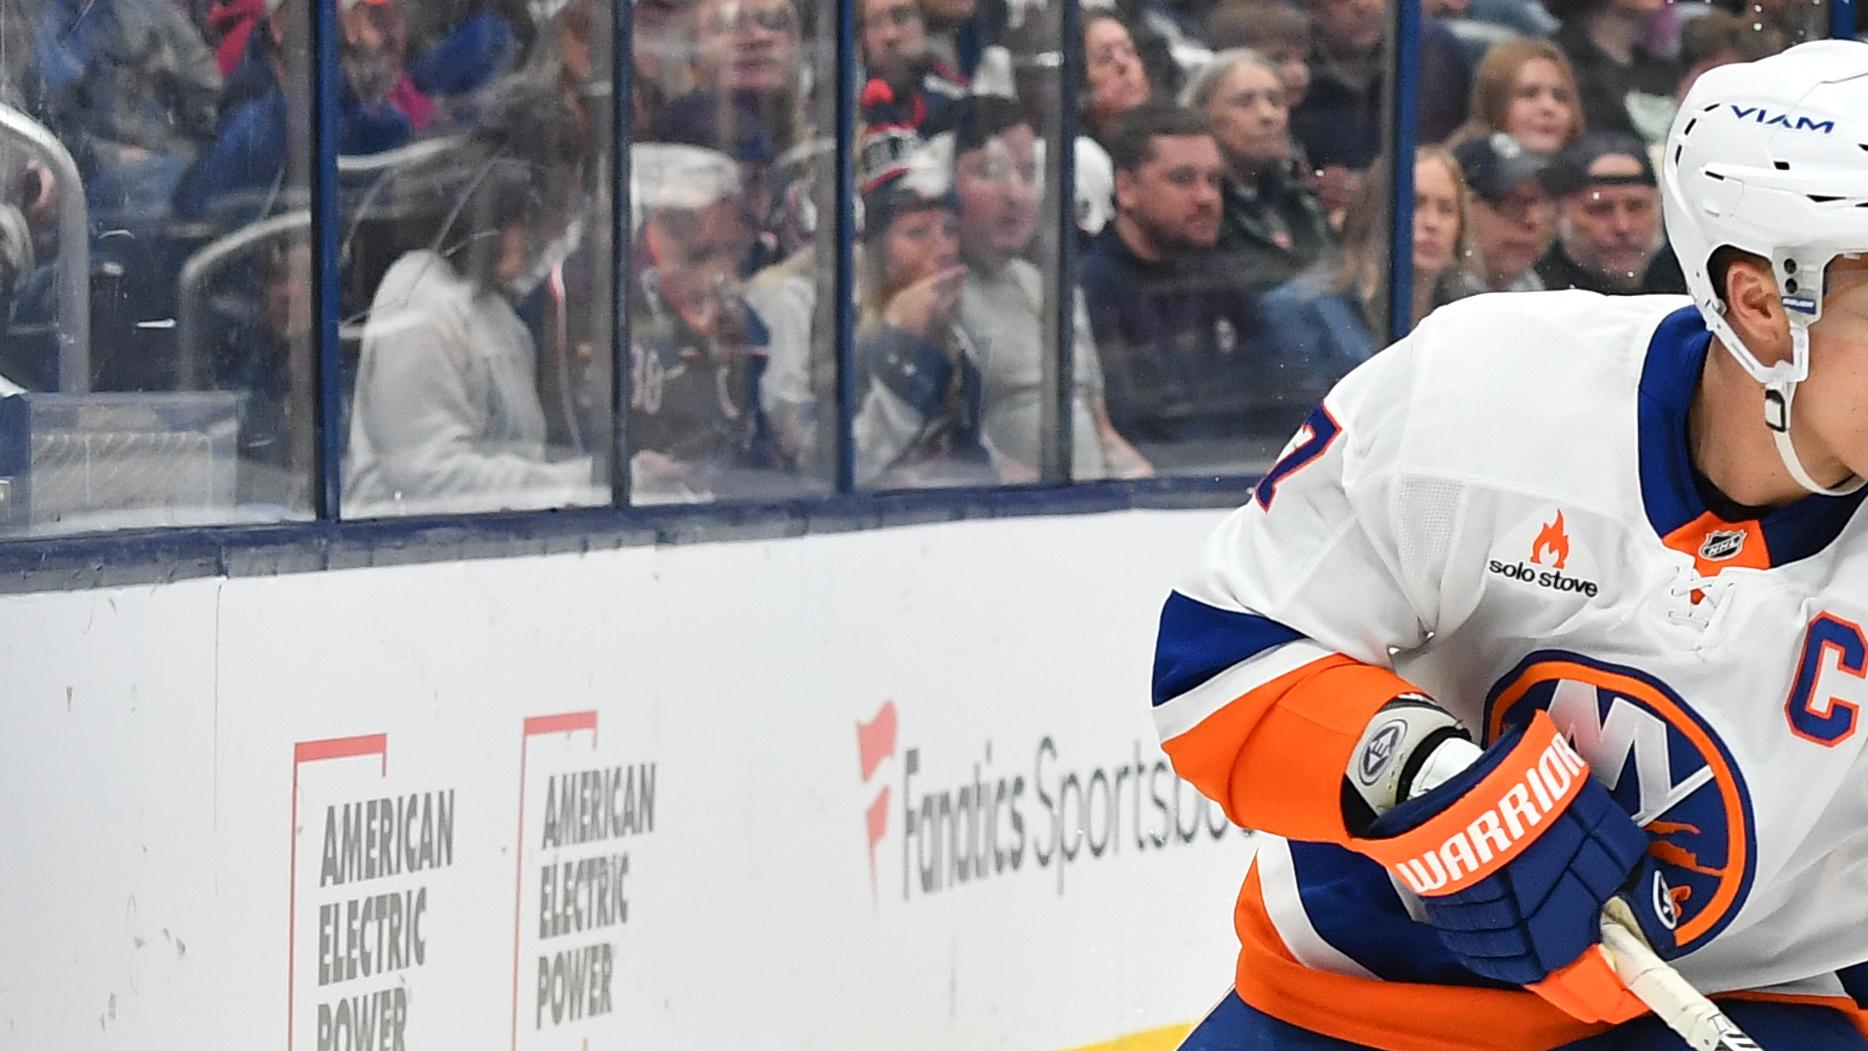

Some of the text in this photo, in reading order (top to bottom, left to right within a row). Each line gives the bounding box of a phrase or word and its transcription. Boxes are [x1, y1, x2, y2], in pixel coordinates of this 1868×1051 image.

[1731, 105, 1835, 134] VIAM
[1489, 560, 1598, 598] solo stove
[319, 788, 455, 887] AMERICAN
[541, 762, 657, 850] AMERICAN
[902, 738, 1026, 900] Fanatics
[1396, 732, 1586, 894] WARRIOR
[318, 886, 427, 986] ELECTRIC
[538, 853, 631, 940] ELECTRIC
[535, 942, 613, 1030] POWER
